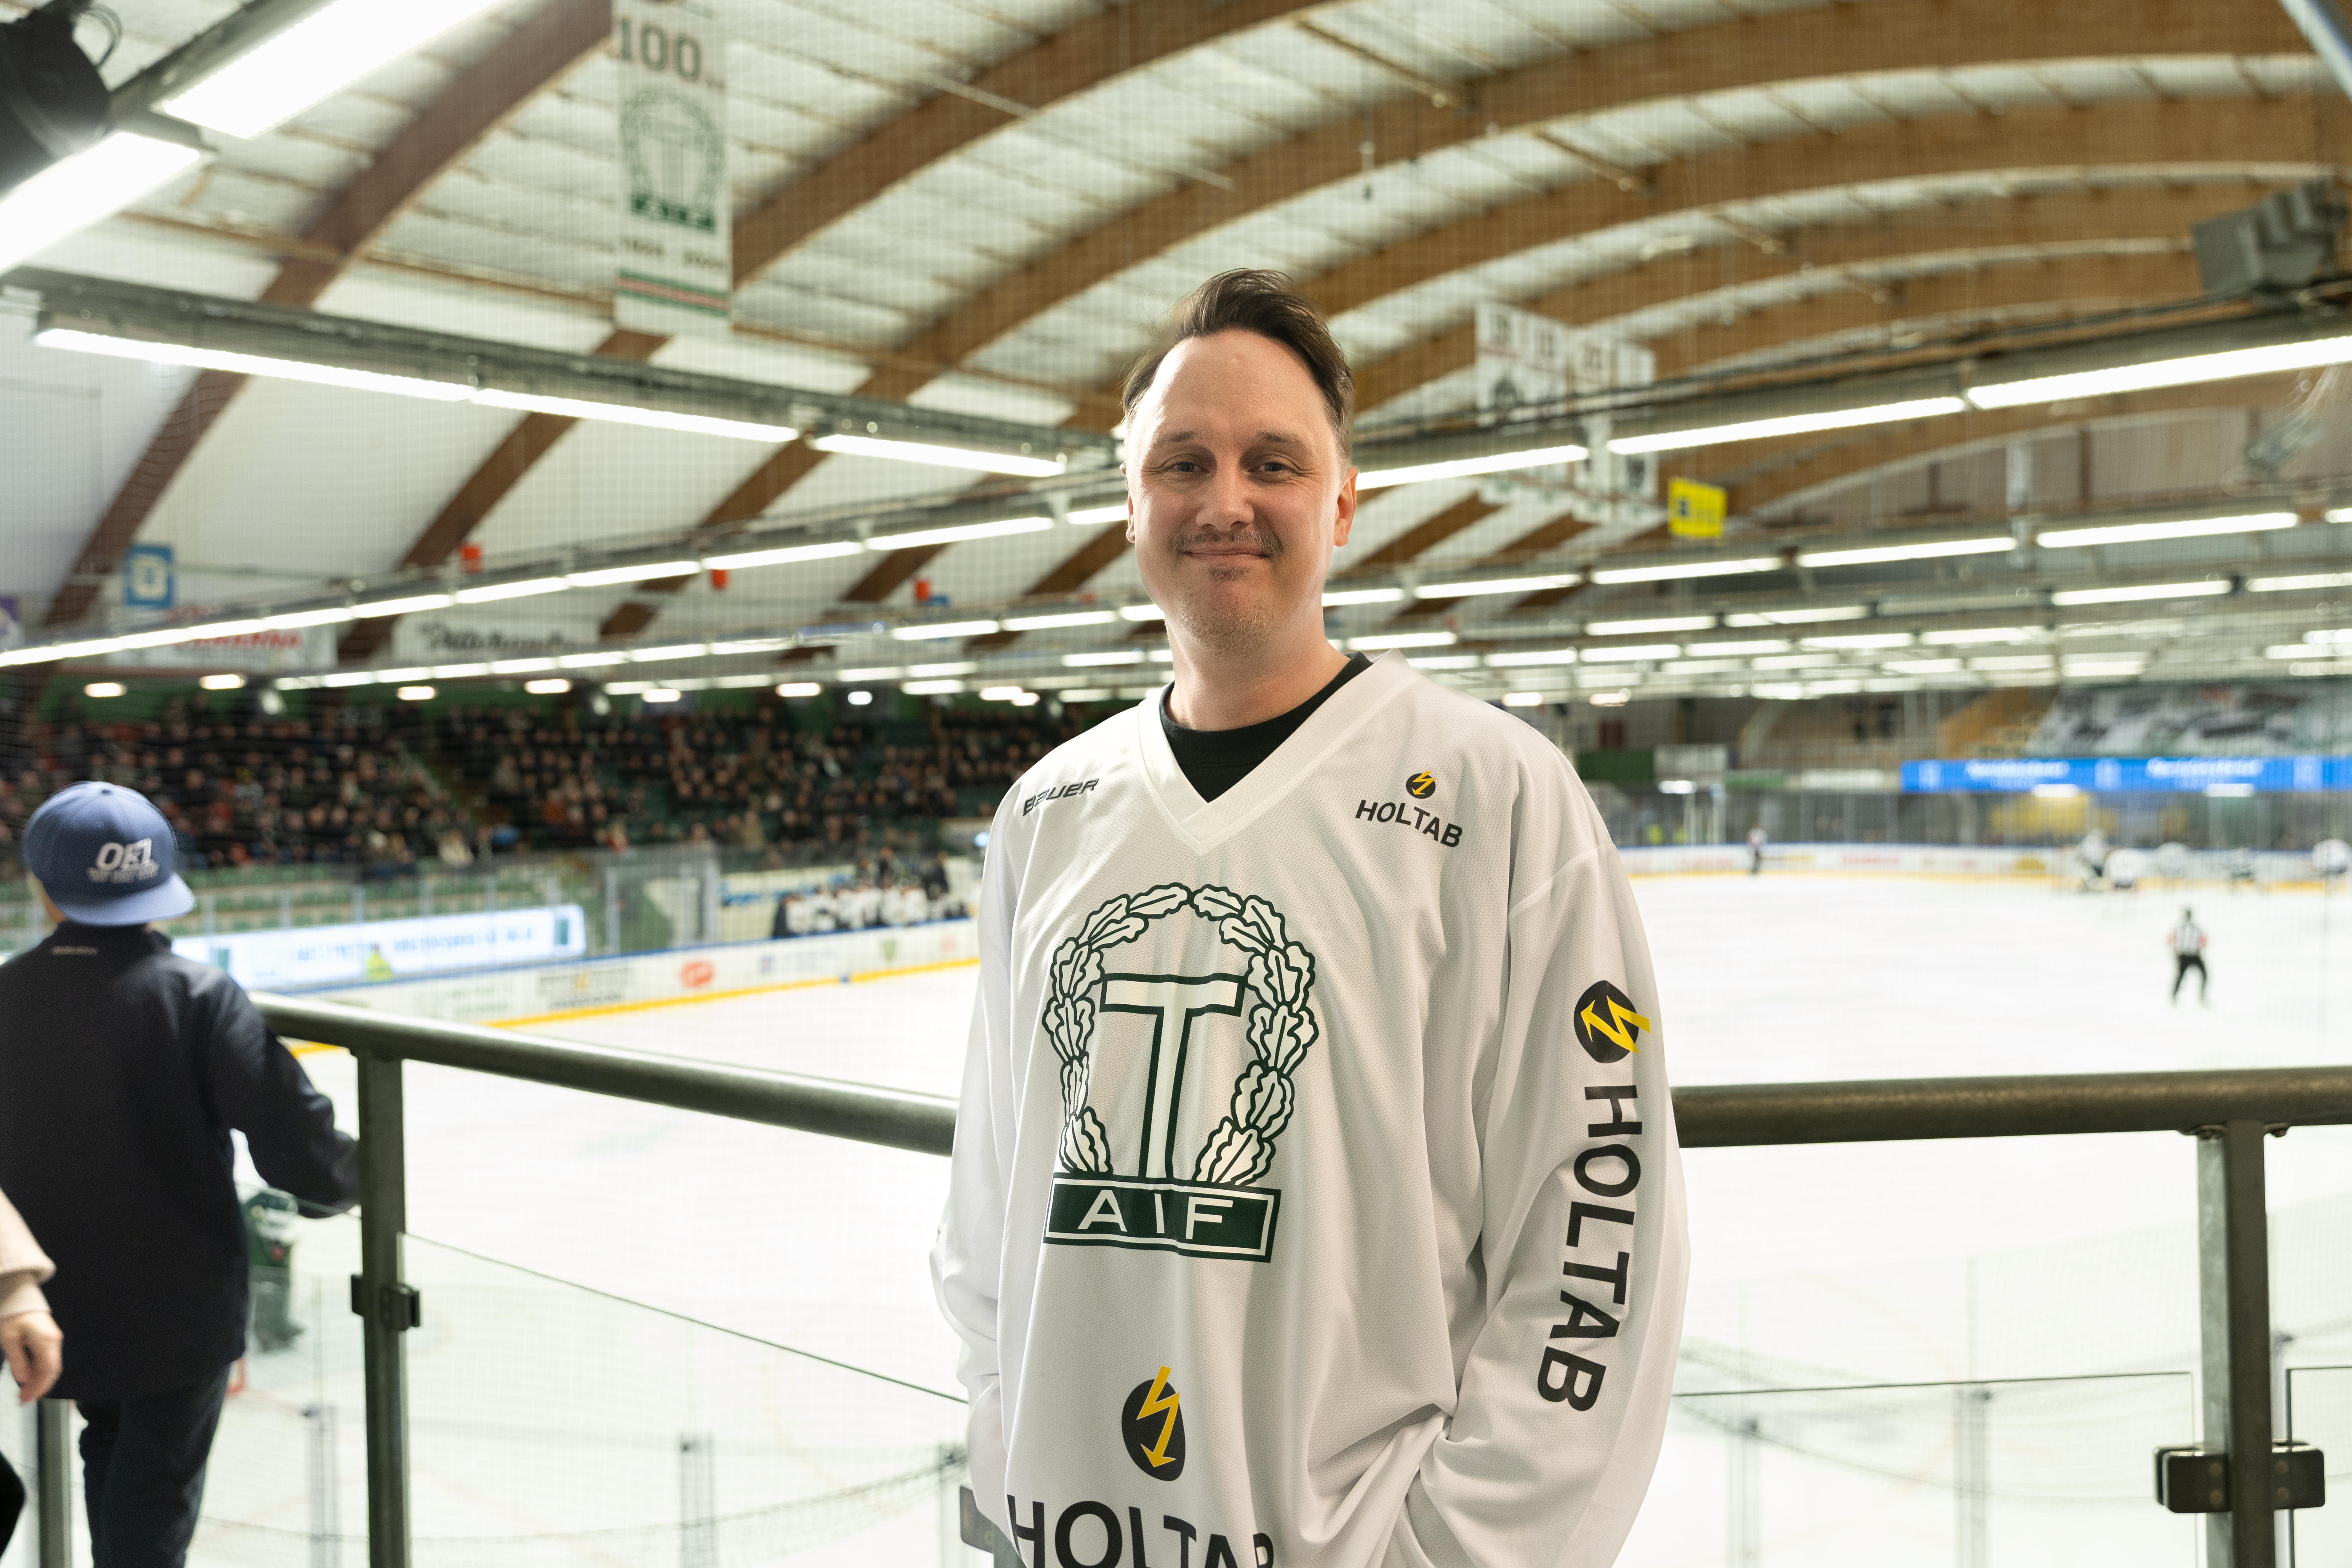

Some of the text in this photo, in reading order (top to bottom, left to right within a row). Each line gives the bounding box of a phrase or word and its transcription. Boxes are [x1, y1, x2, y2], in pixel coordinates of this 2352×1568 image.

[617, 17, 702, 83] 100
[1022, 778, 1100, 817] BAUER
[1355, 799, 1463, 848] HOLTAB
[1077, 1189, 1234, 1240] AIF
[1537, 1084, 1642, 1412] HOLTAB
